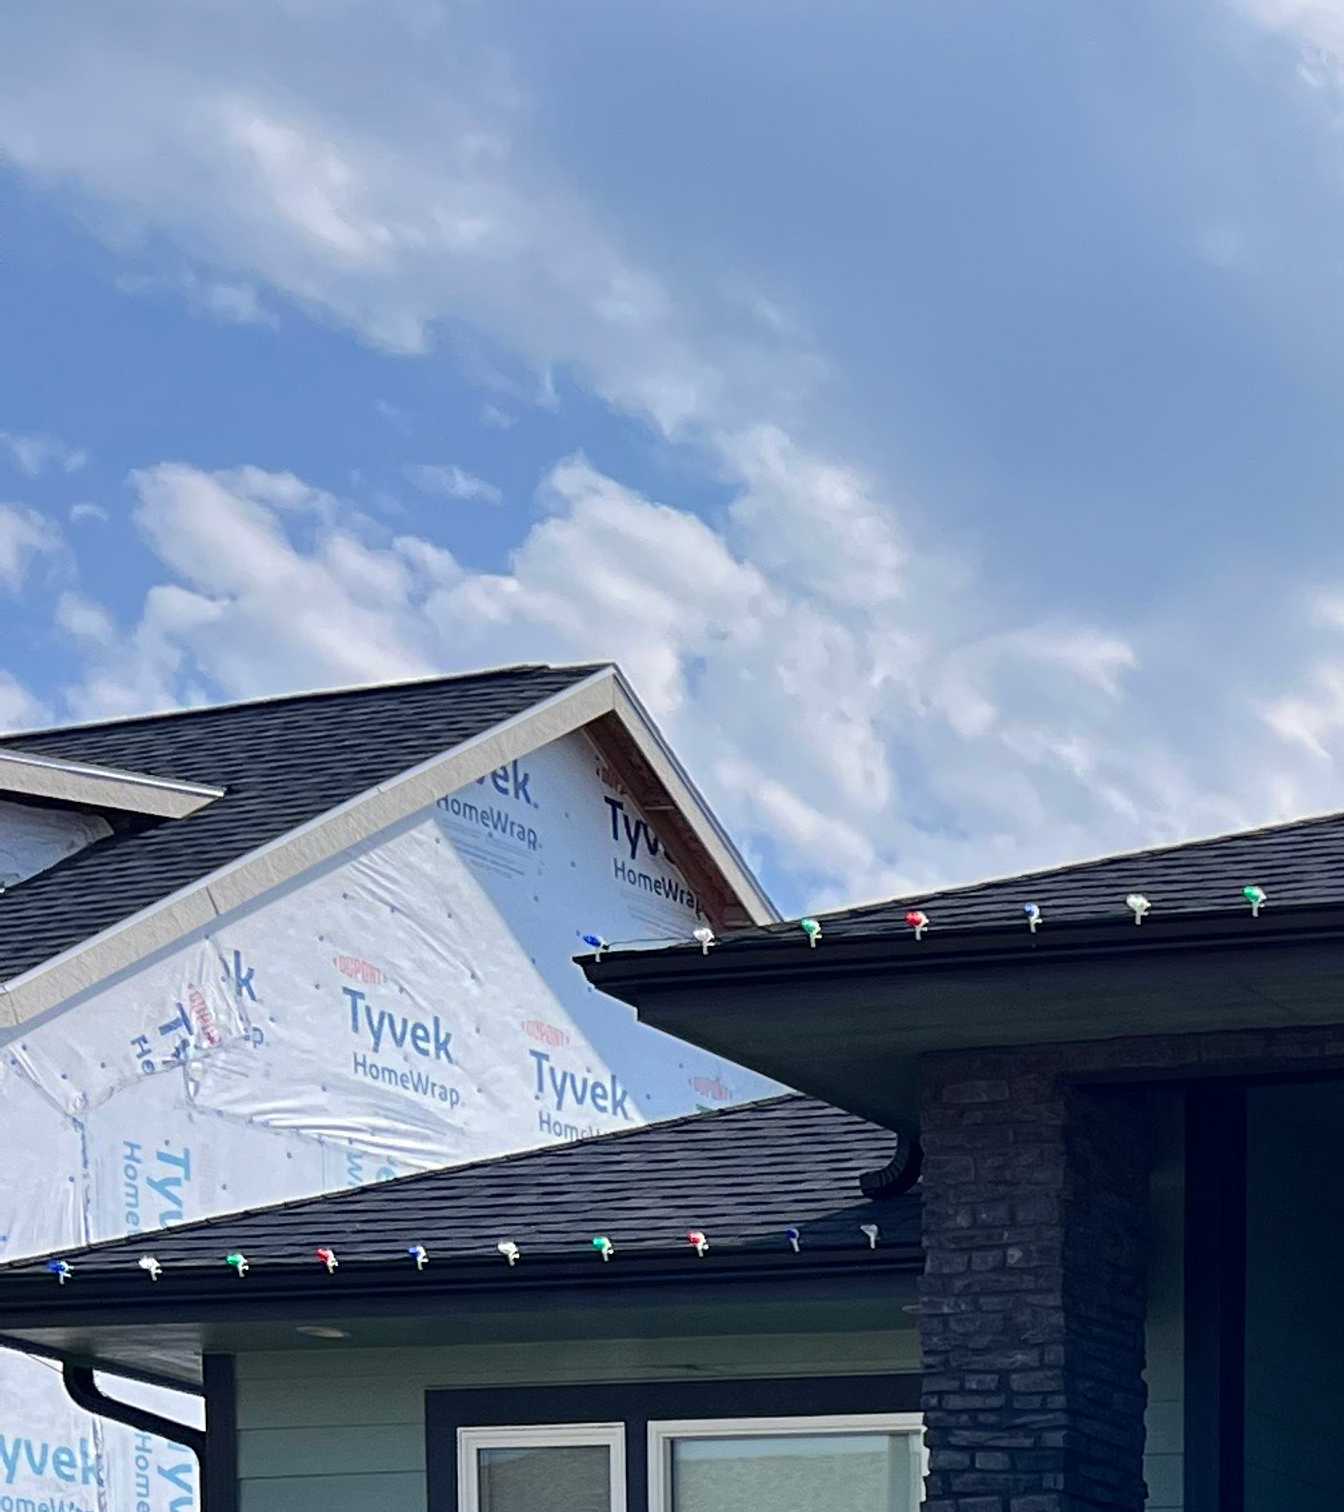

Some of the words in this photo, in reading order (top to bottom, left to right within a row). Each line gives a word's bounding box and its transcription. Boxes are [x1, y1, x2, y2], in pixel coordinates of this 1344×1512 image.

[342, 986, 453, 1064] Tyvek
[353, 1052, 460, 1109] HomeWrap
[529, 1049, 629, 1120] Tyvek
